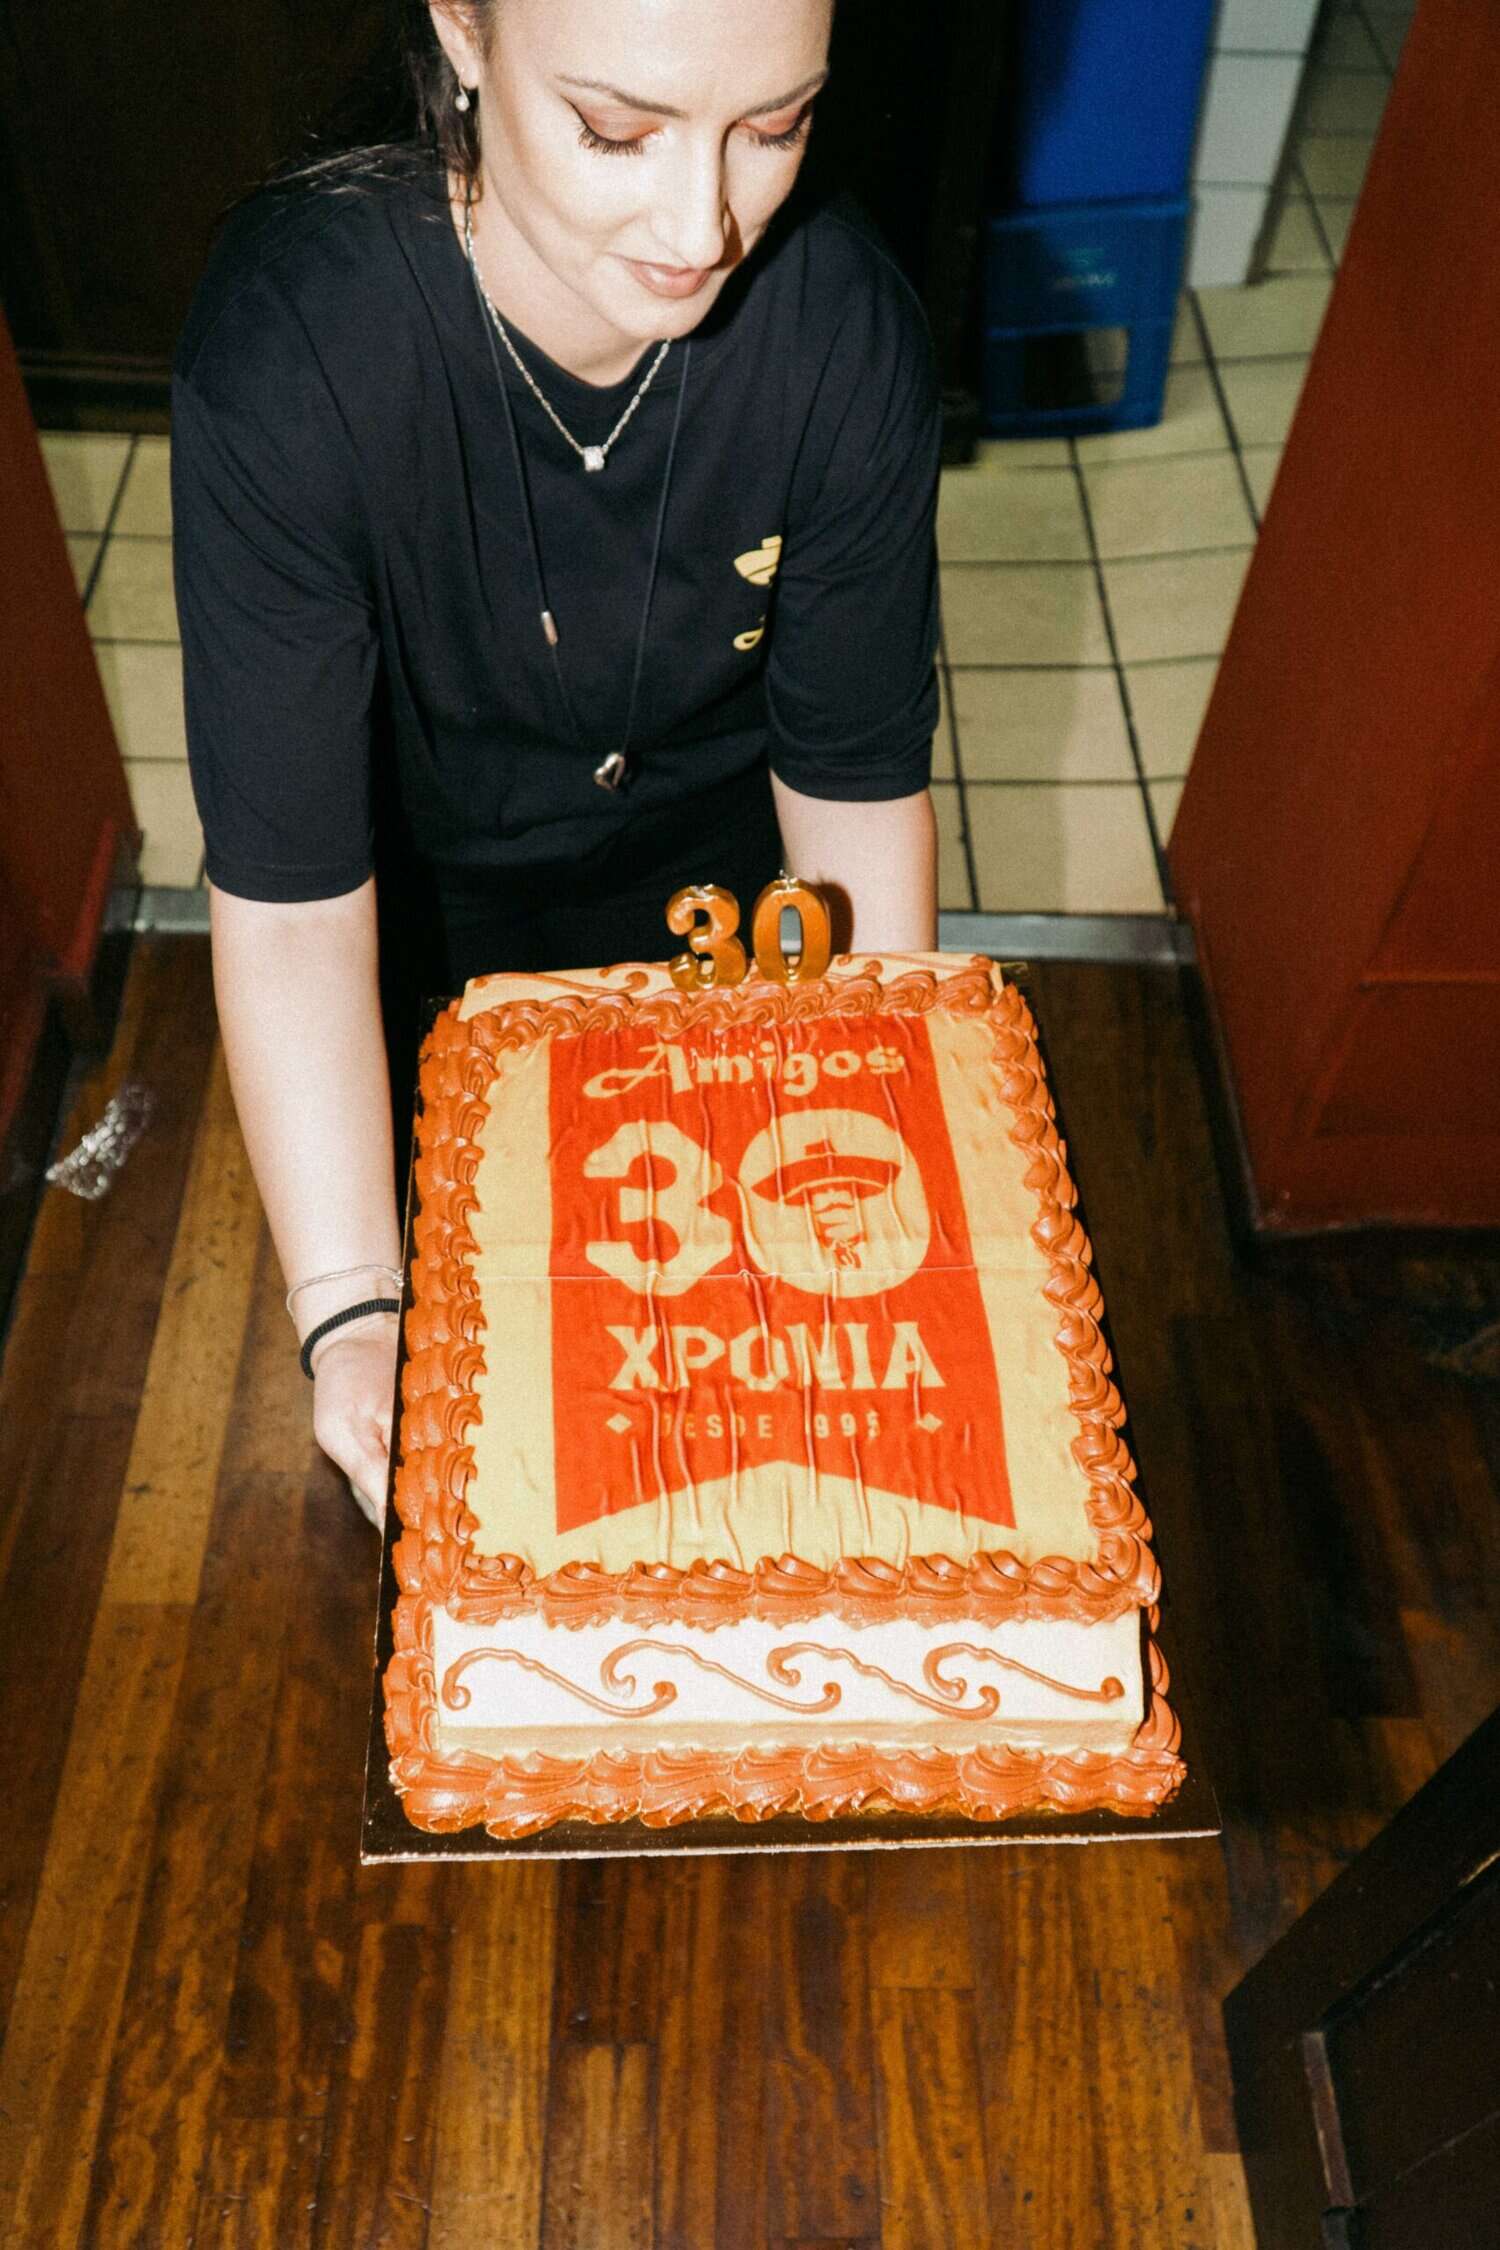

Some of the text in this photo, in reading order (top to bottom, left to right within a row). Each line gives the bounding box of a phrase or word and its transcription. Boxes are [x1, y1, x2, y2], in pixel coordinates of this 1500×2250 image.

[665, 878, 831, 991] 30
[583, 1042, 904, 1098] Amigos
[804, 1408, 880, 1439] 995
